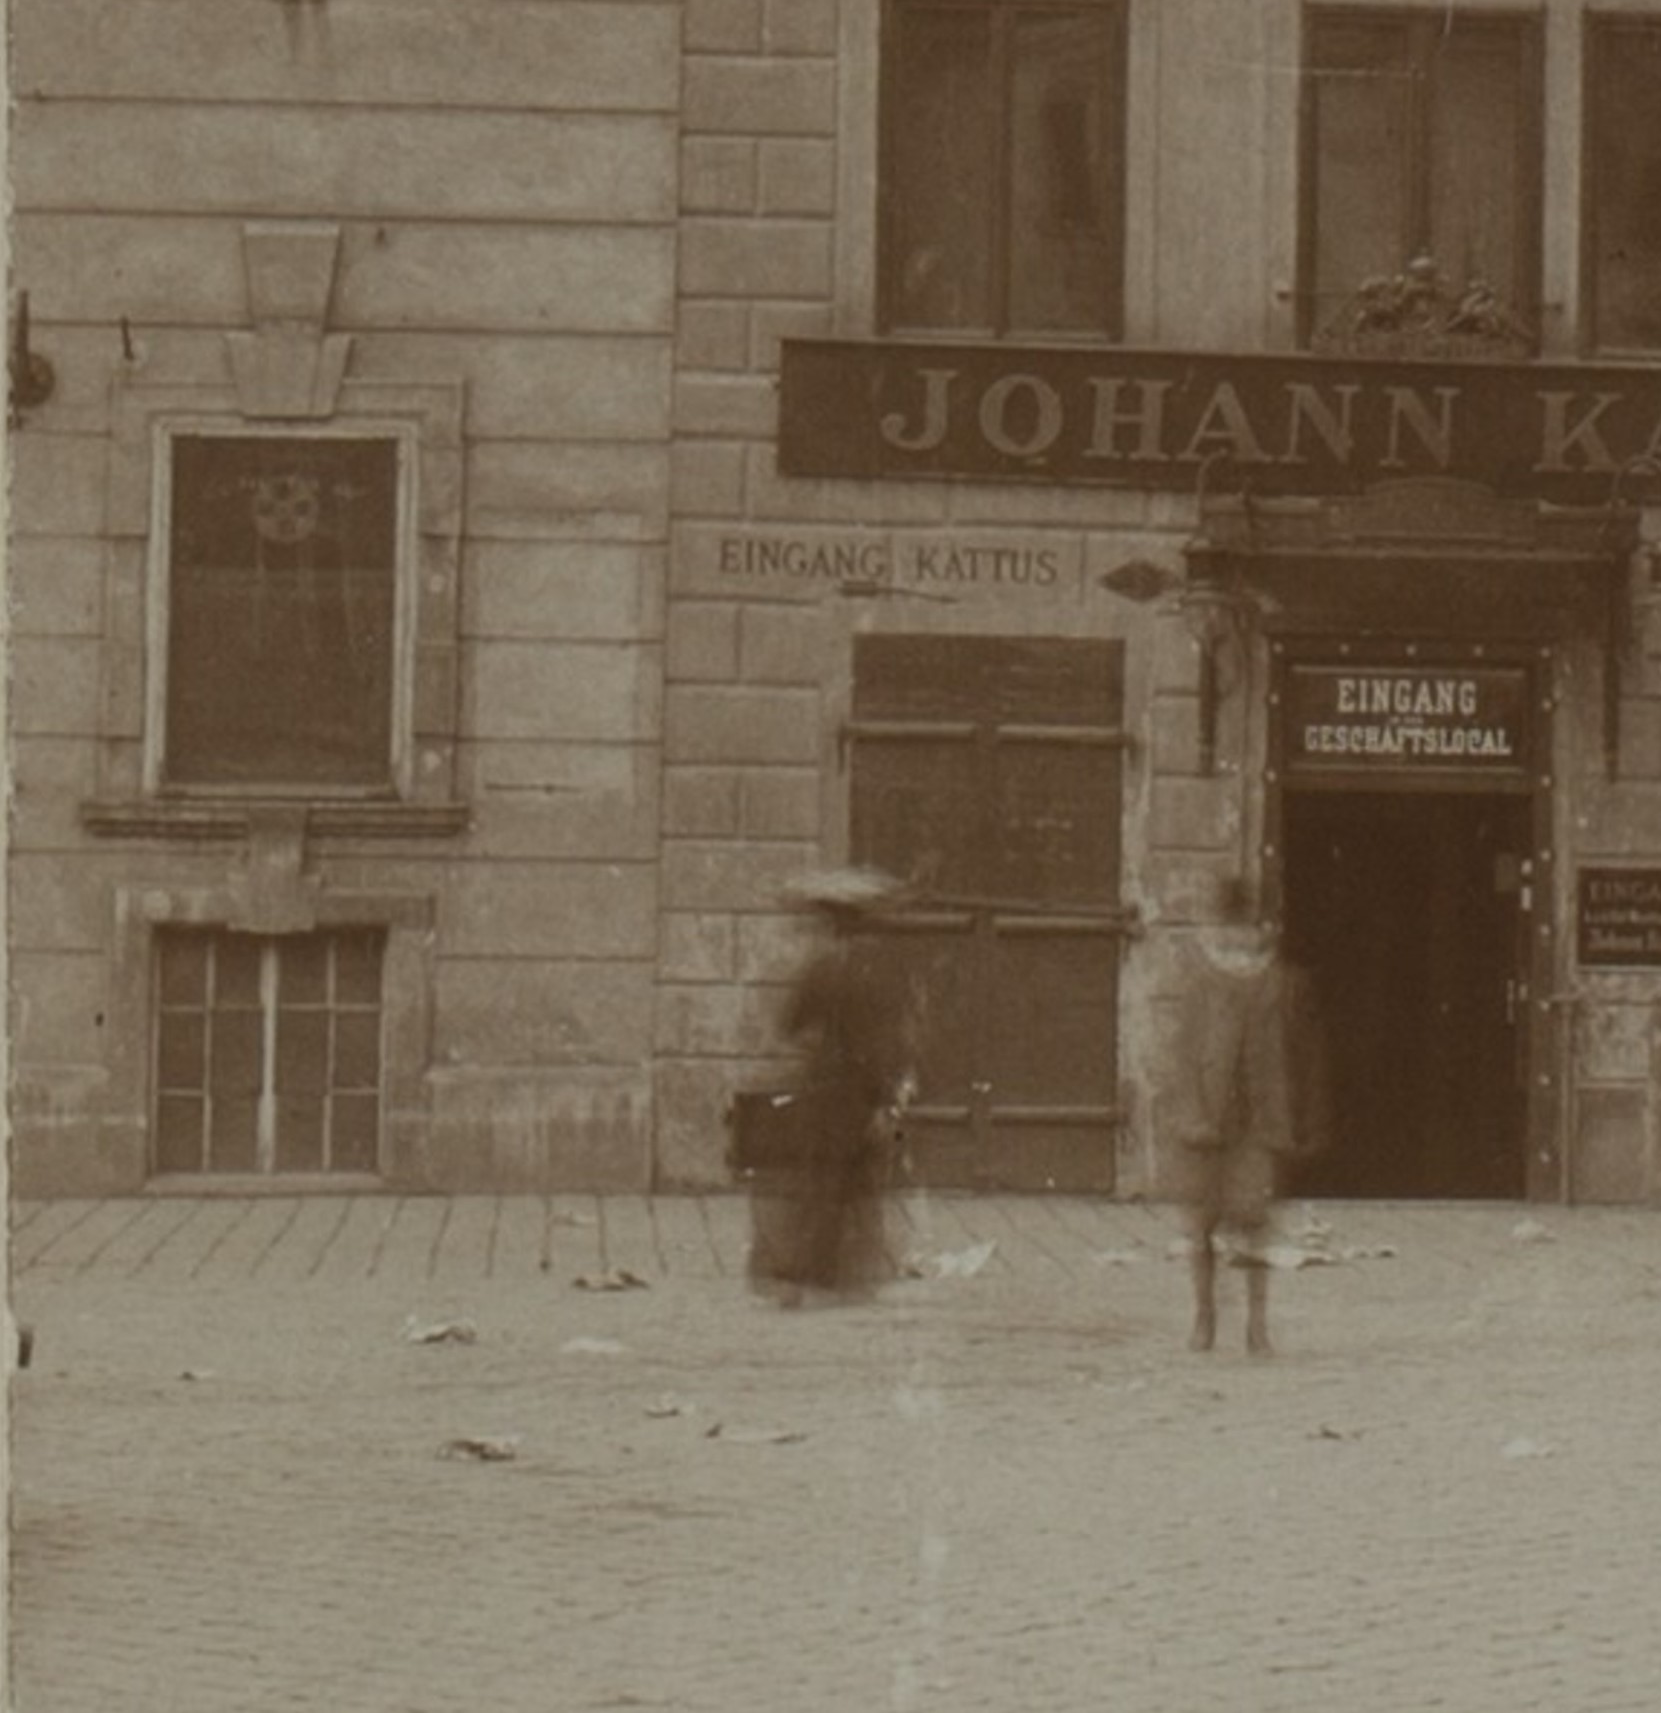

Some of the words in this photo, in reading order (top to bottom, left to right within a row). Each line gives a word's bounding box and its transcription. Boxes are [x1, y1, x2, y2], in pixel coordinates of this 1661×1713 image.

[880, 369, 1460, 469] JOHANN
[719, 539, 886, 578] EINGANG
[915, 545, 1059, 586] KATTUS
[1336, 677, 1478, 716] EINGANG
